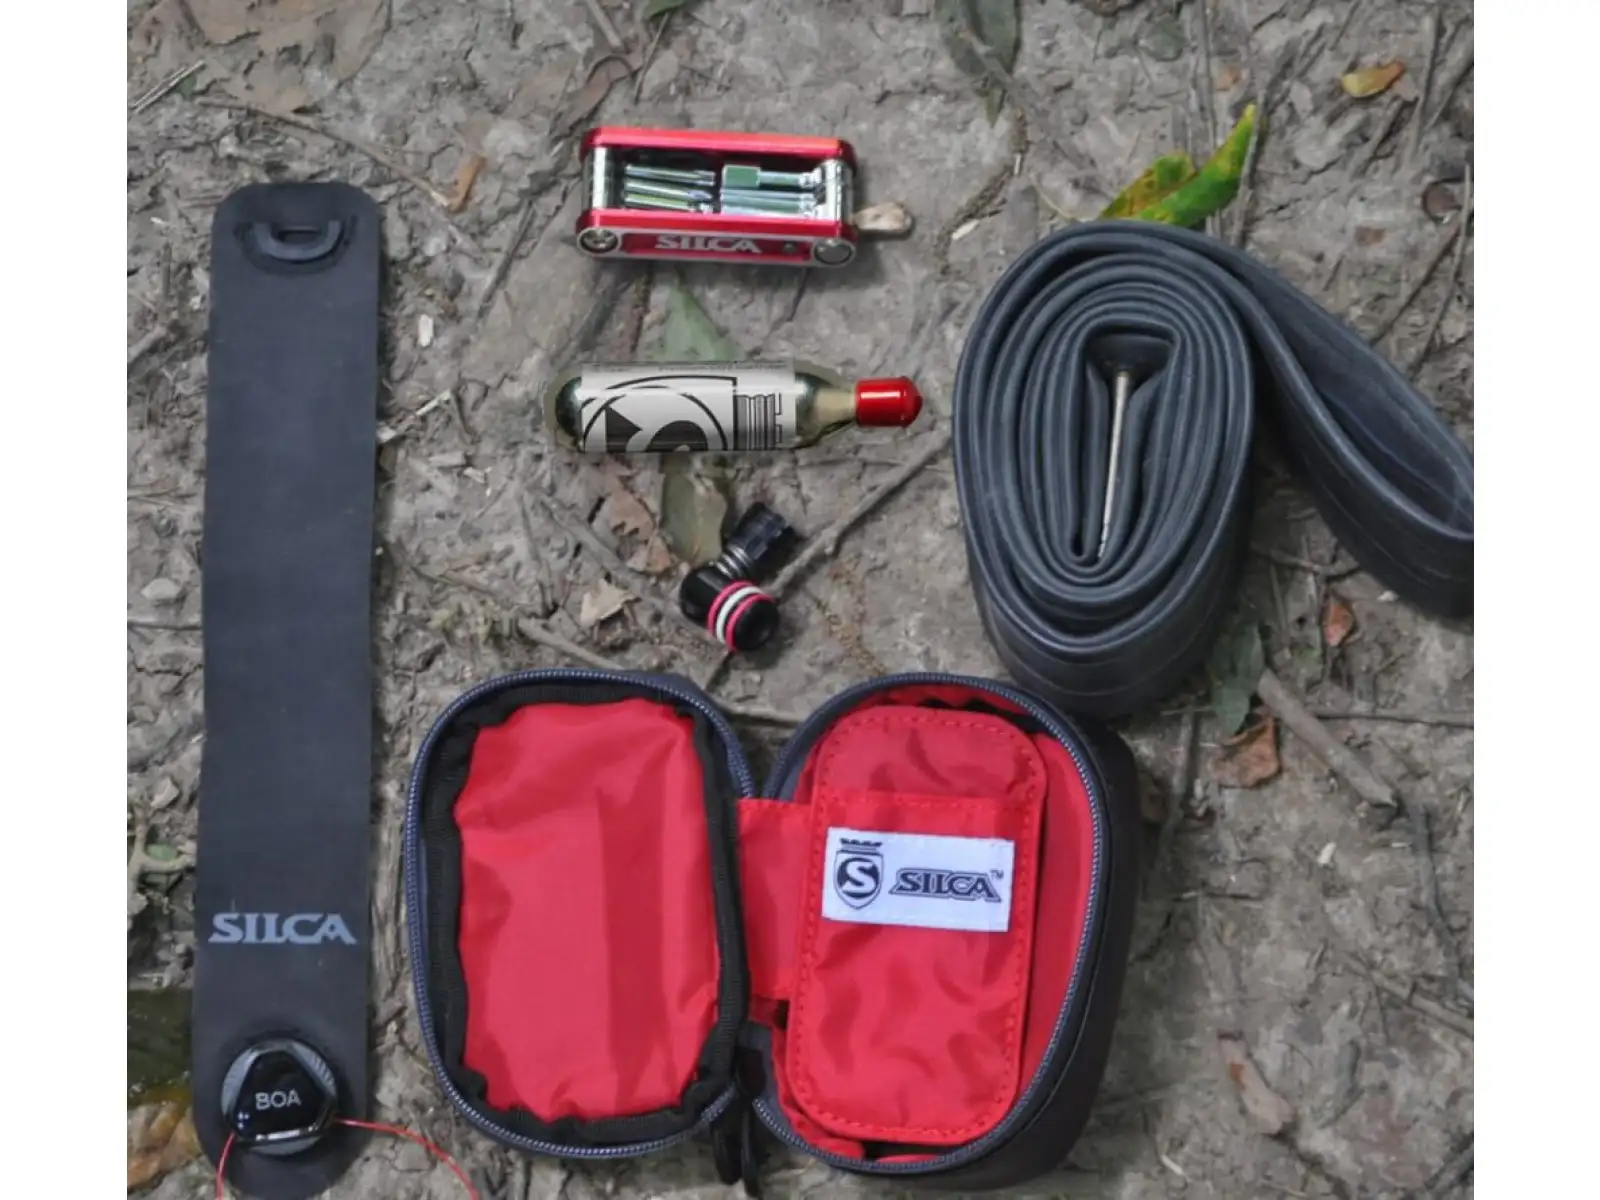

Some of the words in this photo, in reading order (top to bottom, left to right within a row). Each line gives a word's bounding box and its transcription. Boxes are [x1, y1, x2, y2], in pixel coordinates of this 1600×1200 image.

[655, 234, 761, 253] SILCA
[889, 868, 1002, 902] SILCA
[208, 913, 357, 945] SILCA
[255, 1090, 301, 1110] BOA
